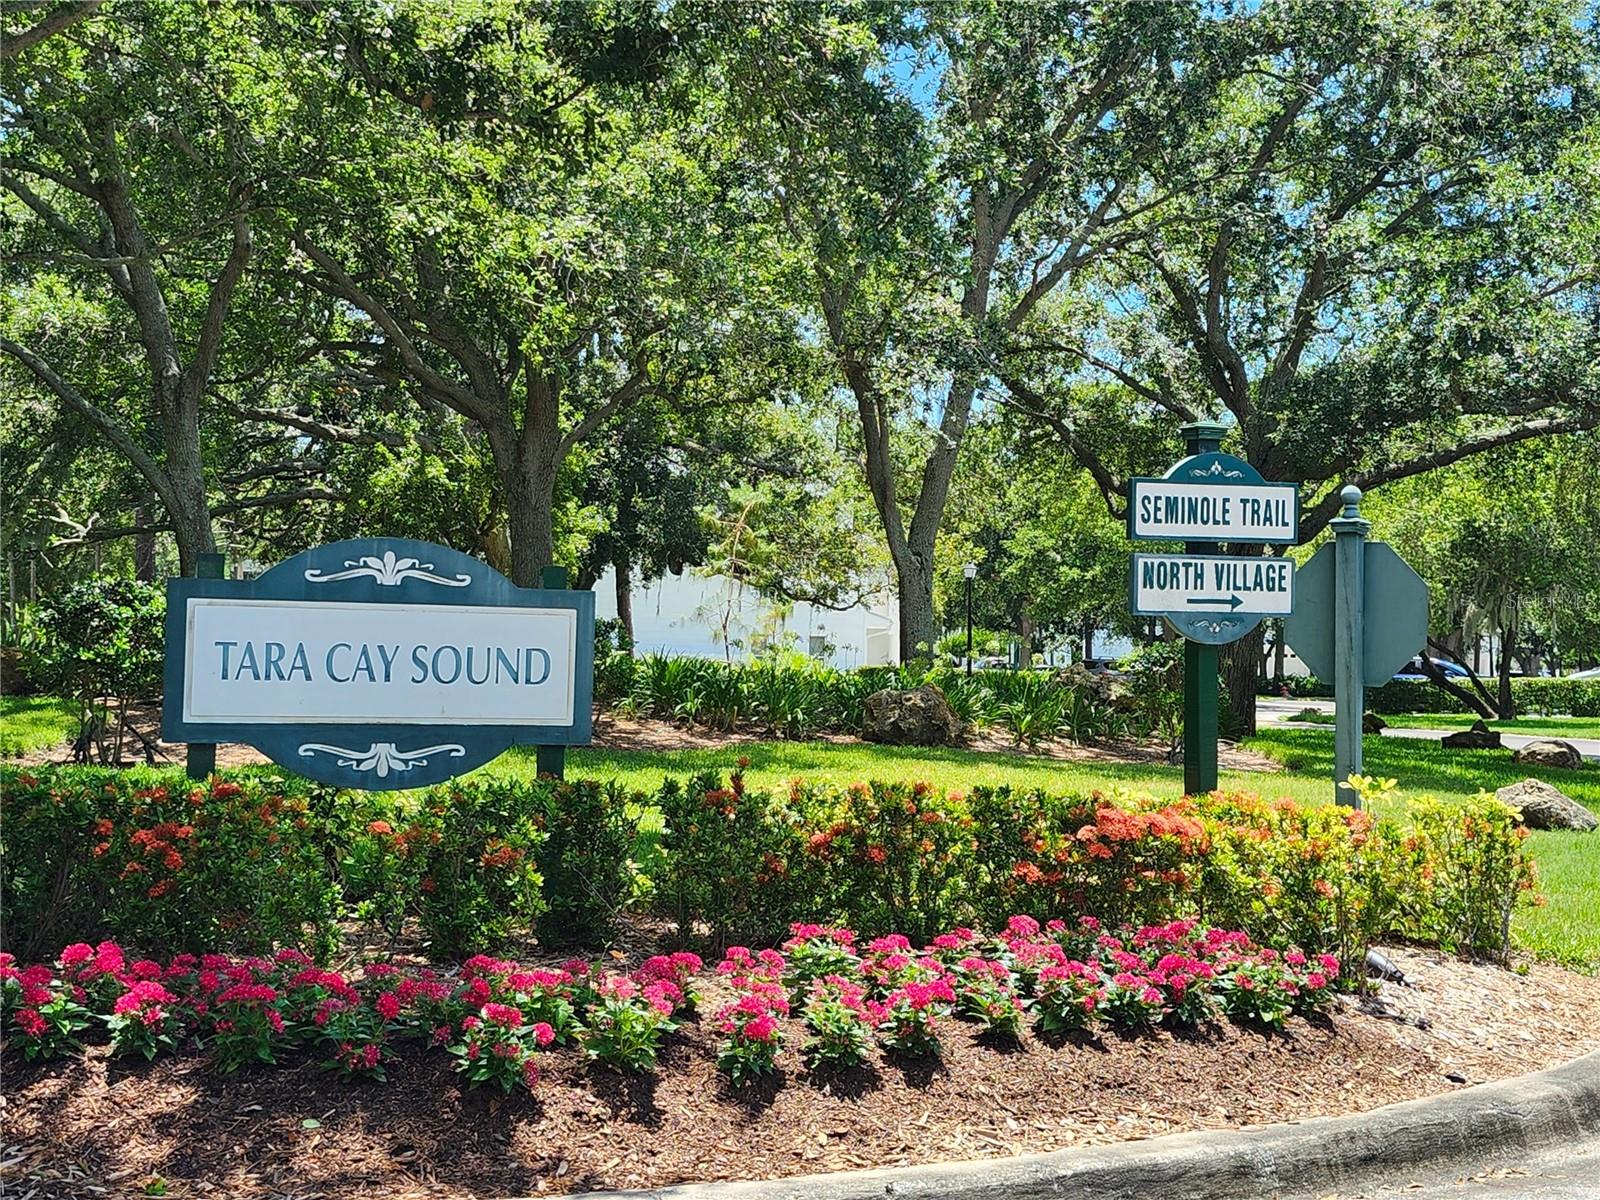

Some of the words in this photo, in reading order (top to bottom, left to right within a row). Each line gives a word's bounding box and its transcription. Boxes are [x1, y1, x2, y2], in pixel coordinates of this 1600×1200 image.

[1140, 495, 1231, 526] SEMINOLE
[1240, 498, 1290, 527] TRAIL
[1142, 561, 1205, 590] NORTH
[1214, 563, 1288, 592] VILLAGE
[214, 640, 314, 682] TARA
[325, 642, 400, 684] CAY
[410, 644, 552, 686] SOUND
